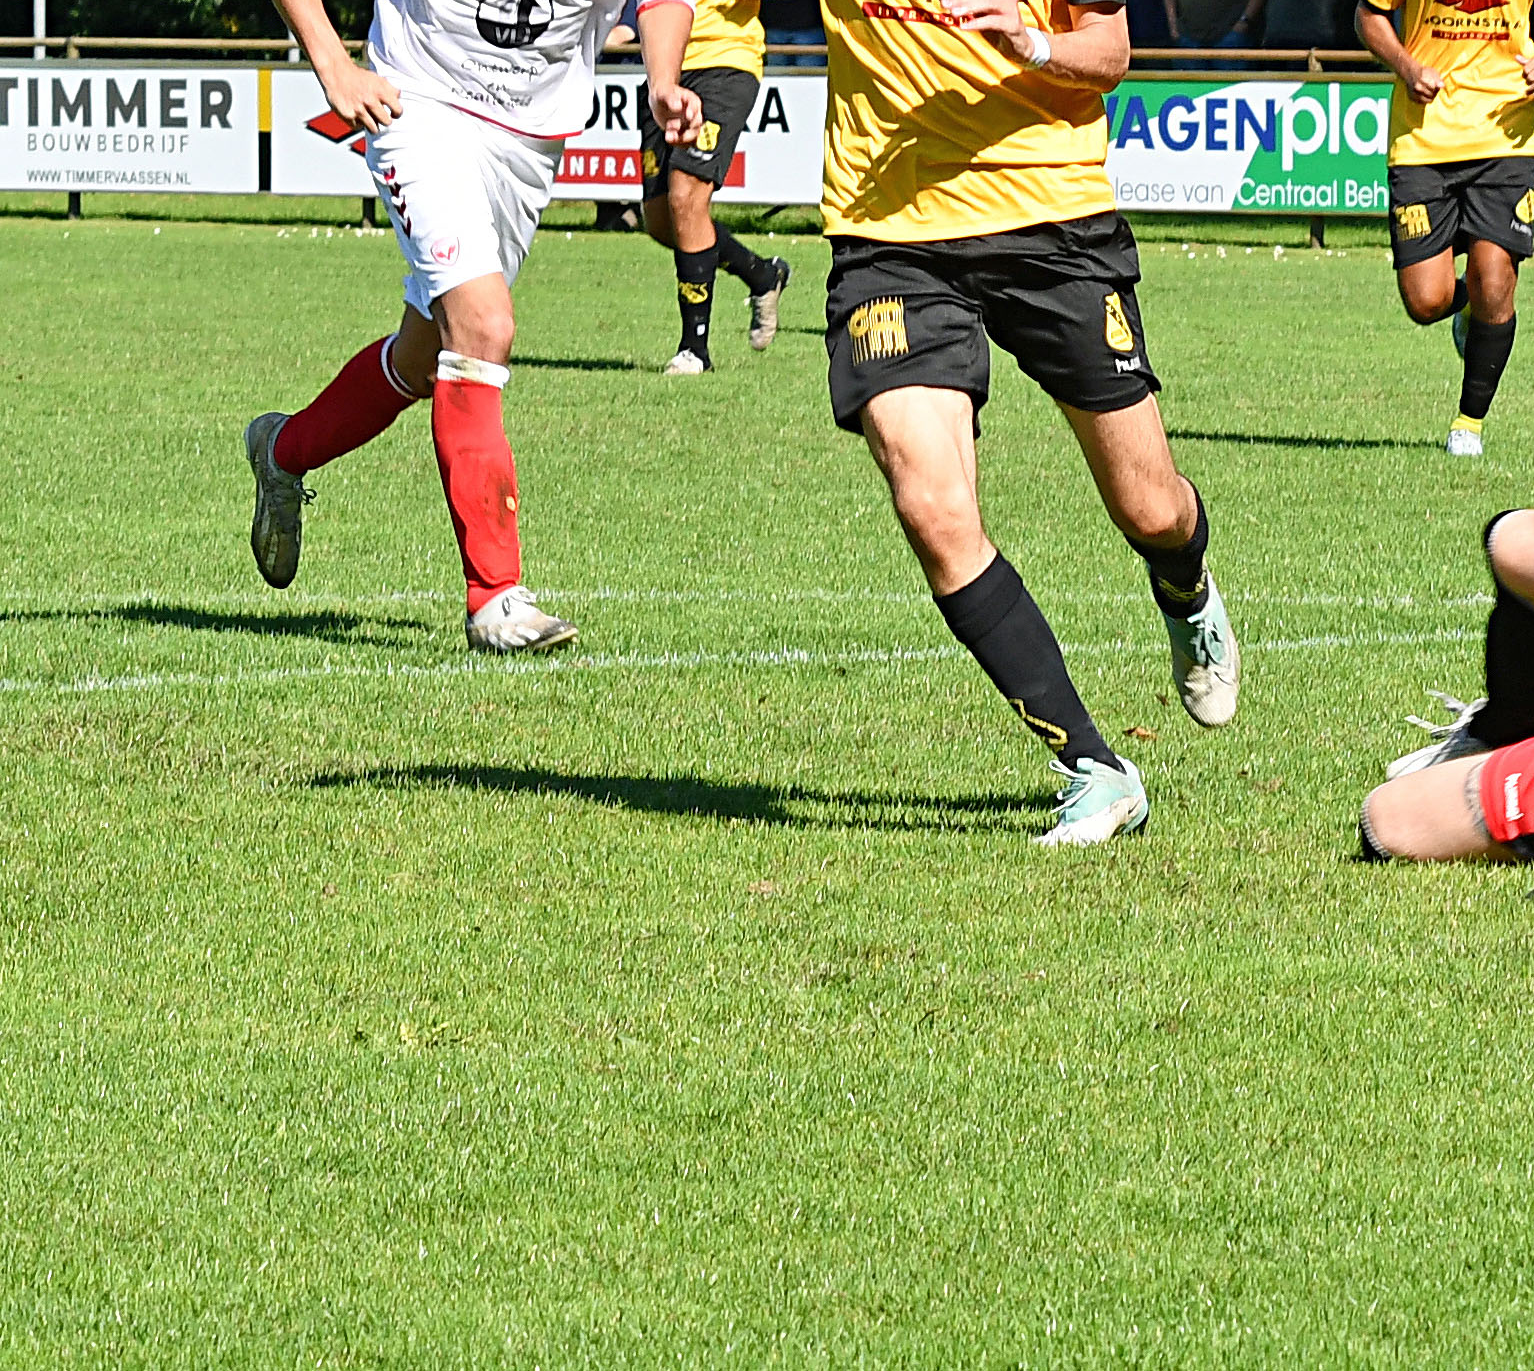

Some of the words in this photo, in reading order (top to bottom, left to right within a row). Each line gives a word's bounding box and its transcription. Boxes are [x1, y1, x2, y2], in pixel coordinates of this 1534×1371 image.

[0, 77, 232, 129] TIMMER
[1107, 82, 1388, 171] AGENpla
[27, 133, 189, 153] BOUWBEDRIJF
[27, 170, 191, 185] WWW.TIMMERVAASSEN.NL
[558, 155, 637, 177] INFRA
[1182, 184, 1224, 203] van
[1236, 177, 1338, 208] Centraal
[1345, 179, 1389, 208] Beh
